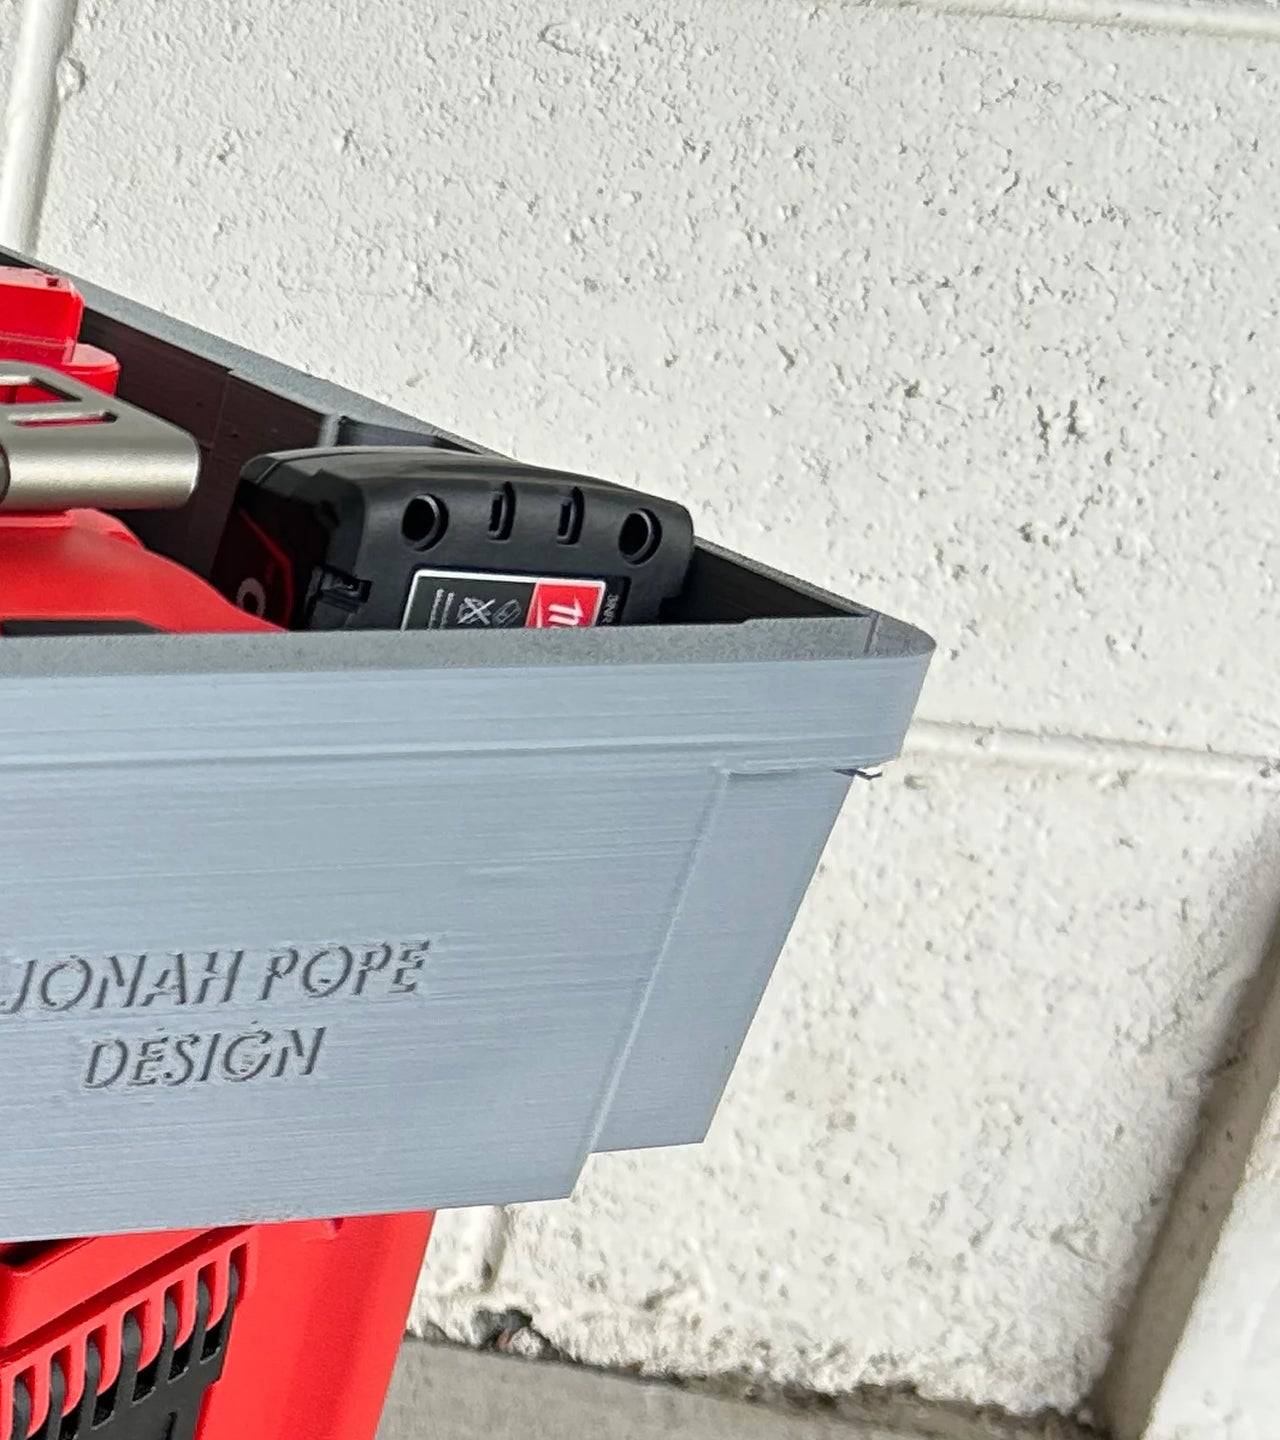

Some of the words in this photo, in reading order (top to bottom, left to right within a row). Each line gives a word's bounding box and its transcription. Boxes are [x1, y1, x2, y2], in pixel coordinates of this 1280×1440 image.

[0, 948, 245, 1016] JONAH
[258, 937, 431, 1001] POPE
[82, 1024, 328, 1090] DESIGN
